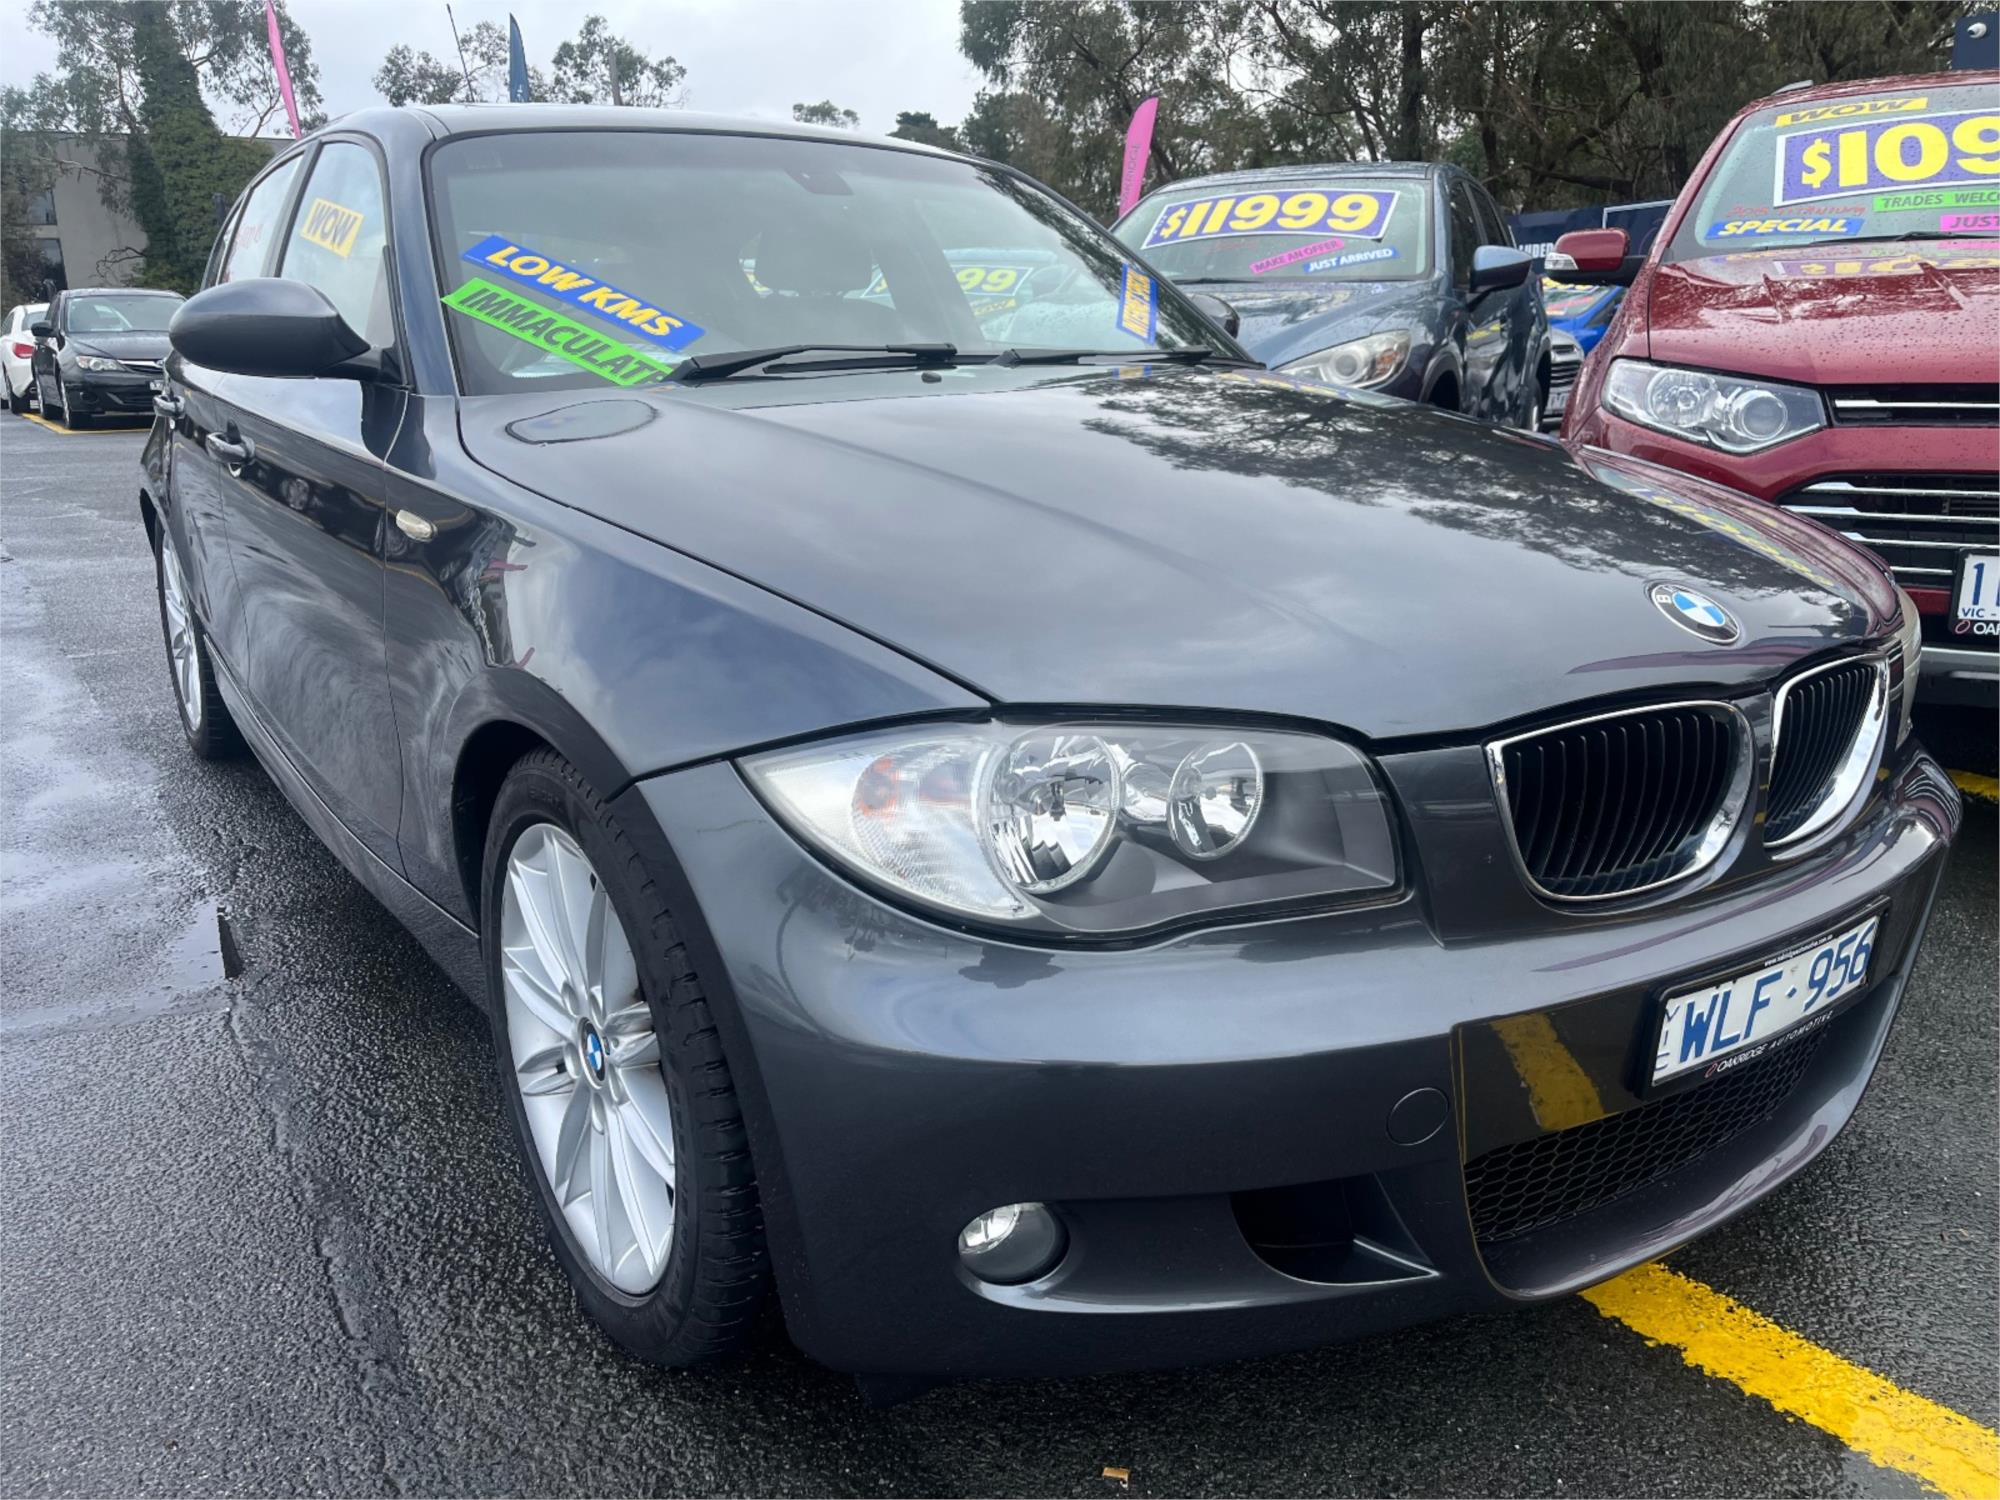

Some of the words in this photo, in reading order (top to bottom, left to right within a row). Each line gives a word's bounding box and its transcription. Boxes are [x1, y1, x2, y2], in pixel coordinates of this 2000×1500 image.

[1791, 99, 1914, 121] WOW
[1882, 193, 1943, 209] TRADES
[1954, 190, 2000, 204] WELC
[306, 201, 358, 249] WOW
[1159, 191, 1380, 239] $11999
[1718, 217, 1848, 236] SPECIAL
[1253, 253, 1286, 272] MAKE
[1288, 249, 1305, 263] AN
[1306, 240, 1339, 257] OFFER
[1308, 257, 1338, 272] JUST
[1341, 248, 1393, 266] ARRIVED
[485, 245, 595, 292] LOW
[577, 286, 684, 337] KMS
[1962, 607, 1986, 618] VIC
[1973, 621, 2000, 636] OA
